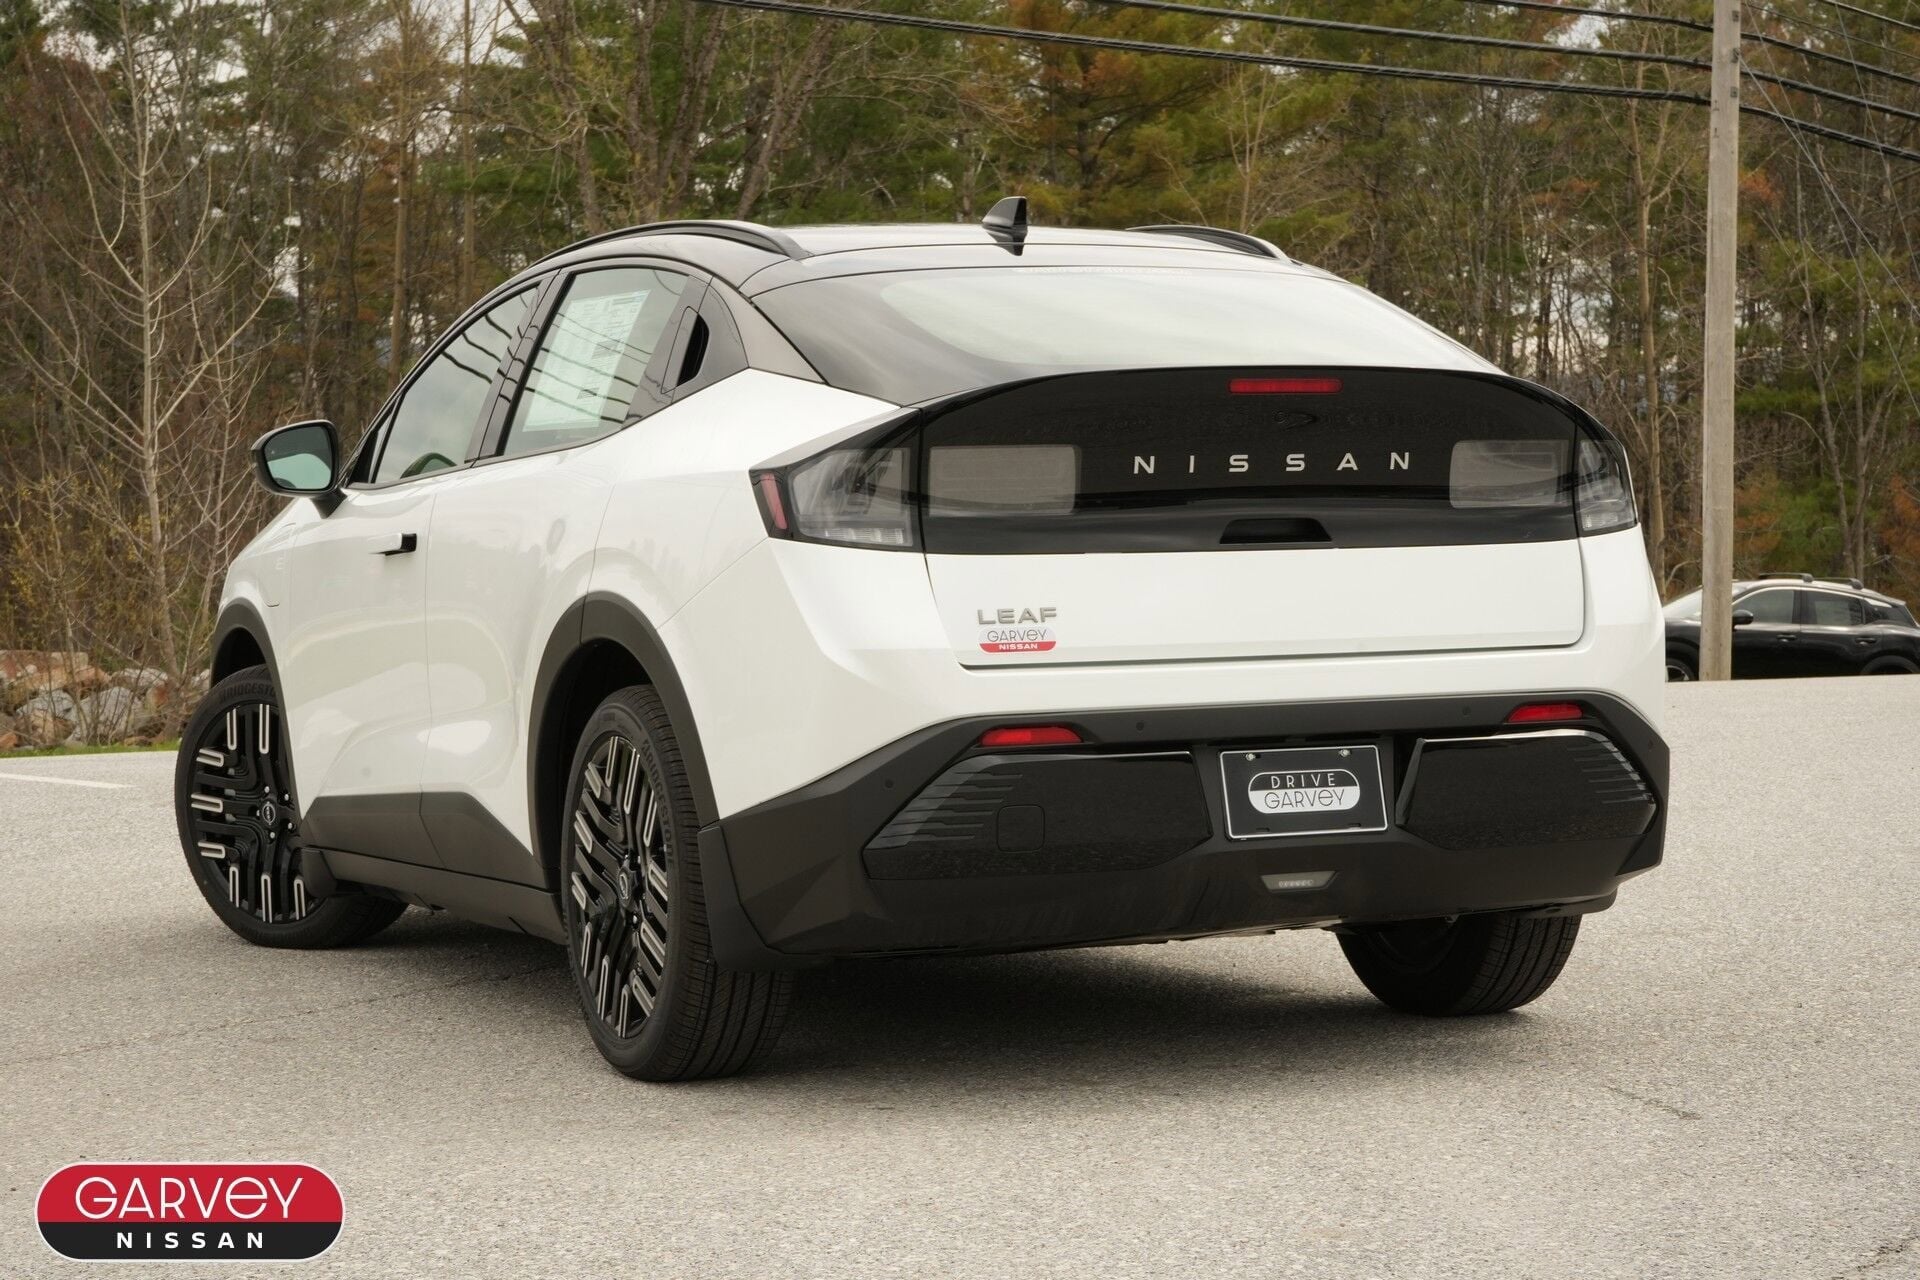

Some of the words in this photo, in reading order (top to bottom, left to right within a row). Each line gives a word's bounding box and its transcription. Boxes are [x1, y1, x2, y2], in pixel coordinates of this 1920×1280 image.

[1133, 452, 1410, 475] NISSAN
[977, 607, 1057, 625] LEAF
[1270, 773, 1336, 789] DRIVE
